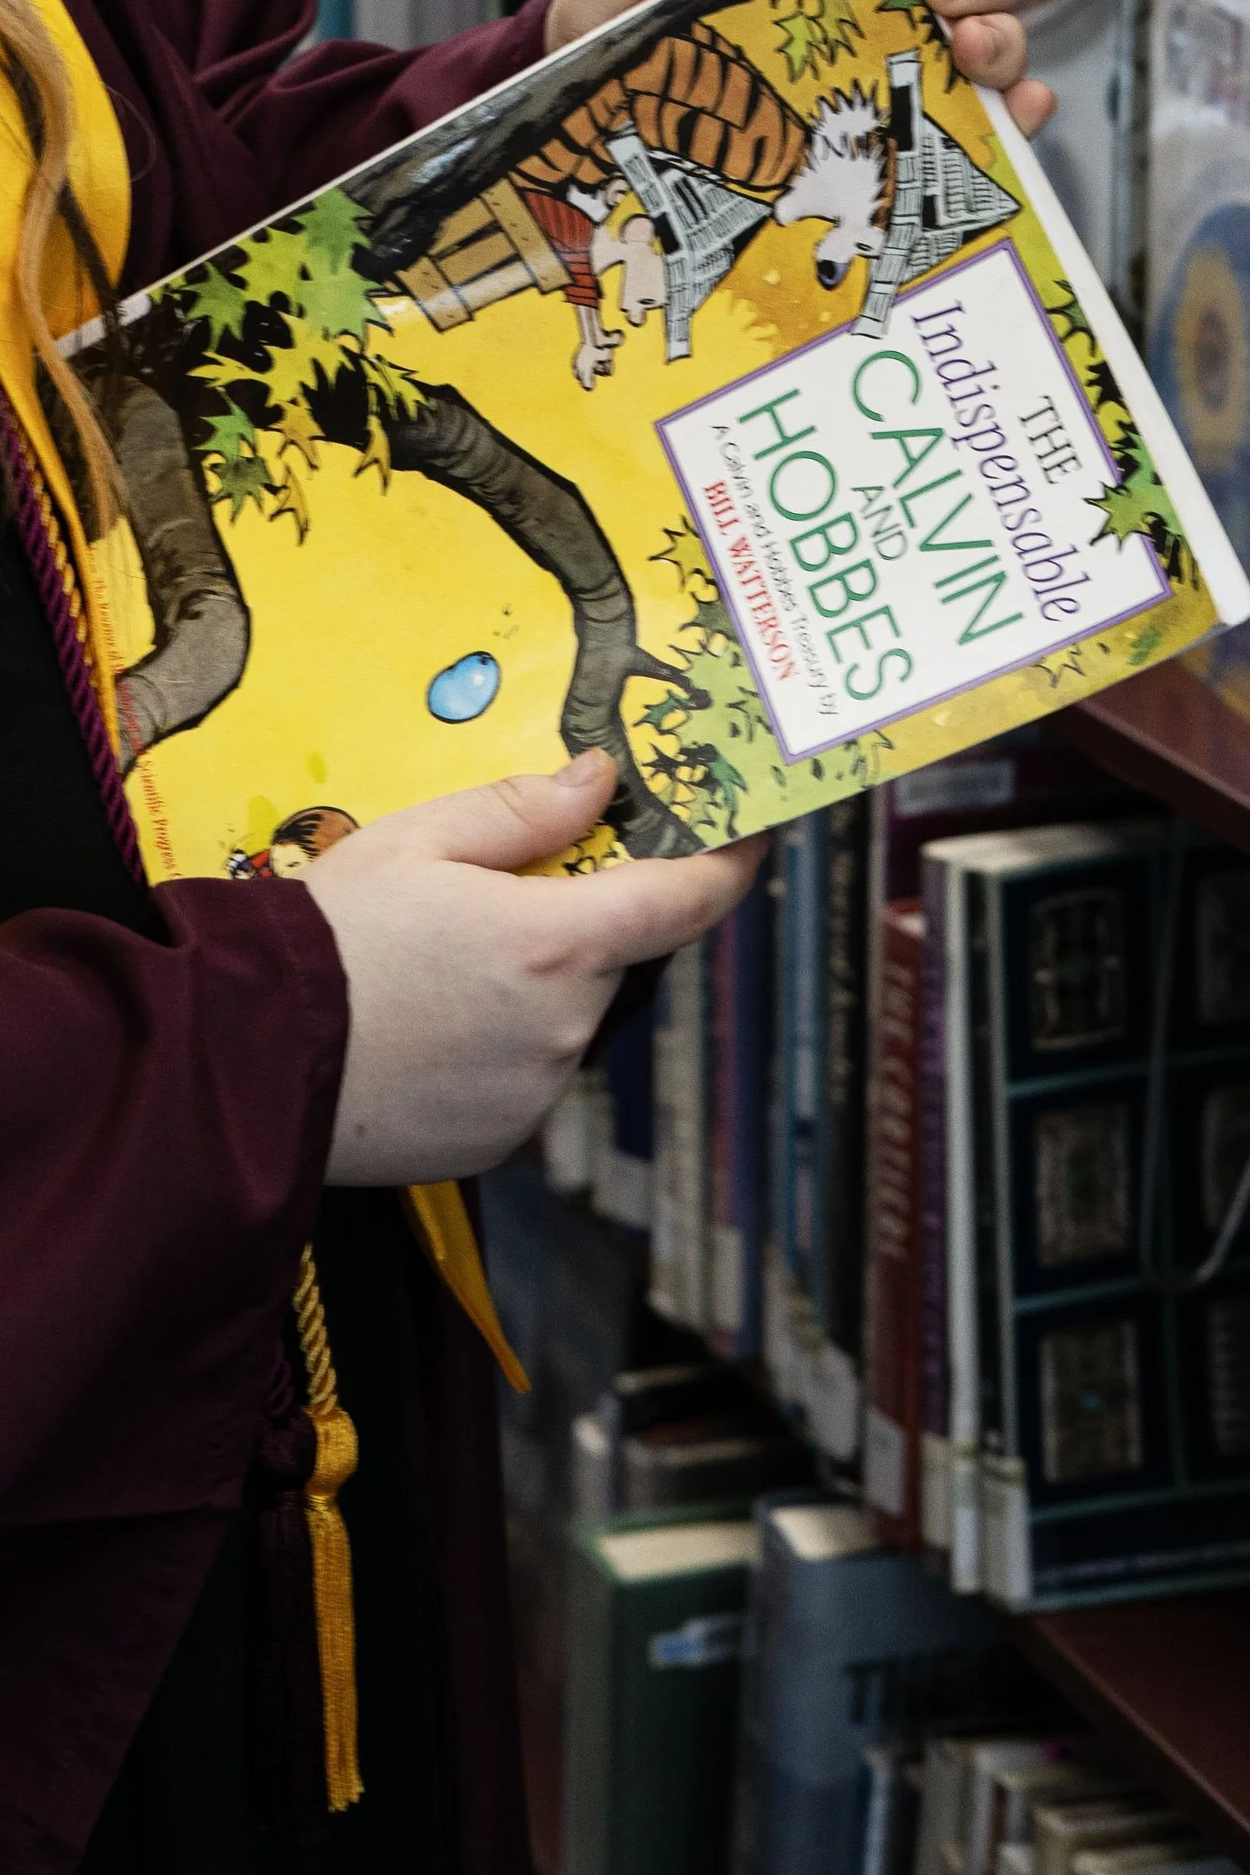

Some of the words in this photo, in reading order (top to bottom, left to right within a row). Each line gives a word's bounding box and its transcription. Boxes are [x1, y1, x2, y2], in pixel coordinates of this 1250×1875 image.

[710, 425, 731, 441] A
[719, 441, 754, 500] Calvin
[910, 299, 1094, 624] Indispensable
[1019, 395, 1082, 485] THE
[744, 502, 774, 538] and
[851, 484, 909, 562] AND
[852, 350, 1023, 647] CALVIN
[703, 479, 741, 536] BILL
[729, 535, 801, 681] WATTERSON
[738, 388, 914, 702] HOBBES
[760, 541, 800, 613] Hobbes
[789, 613, 831, 688] Treasury
[817, 691, 841, 715] by
